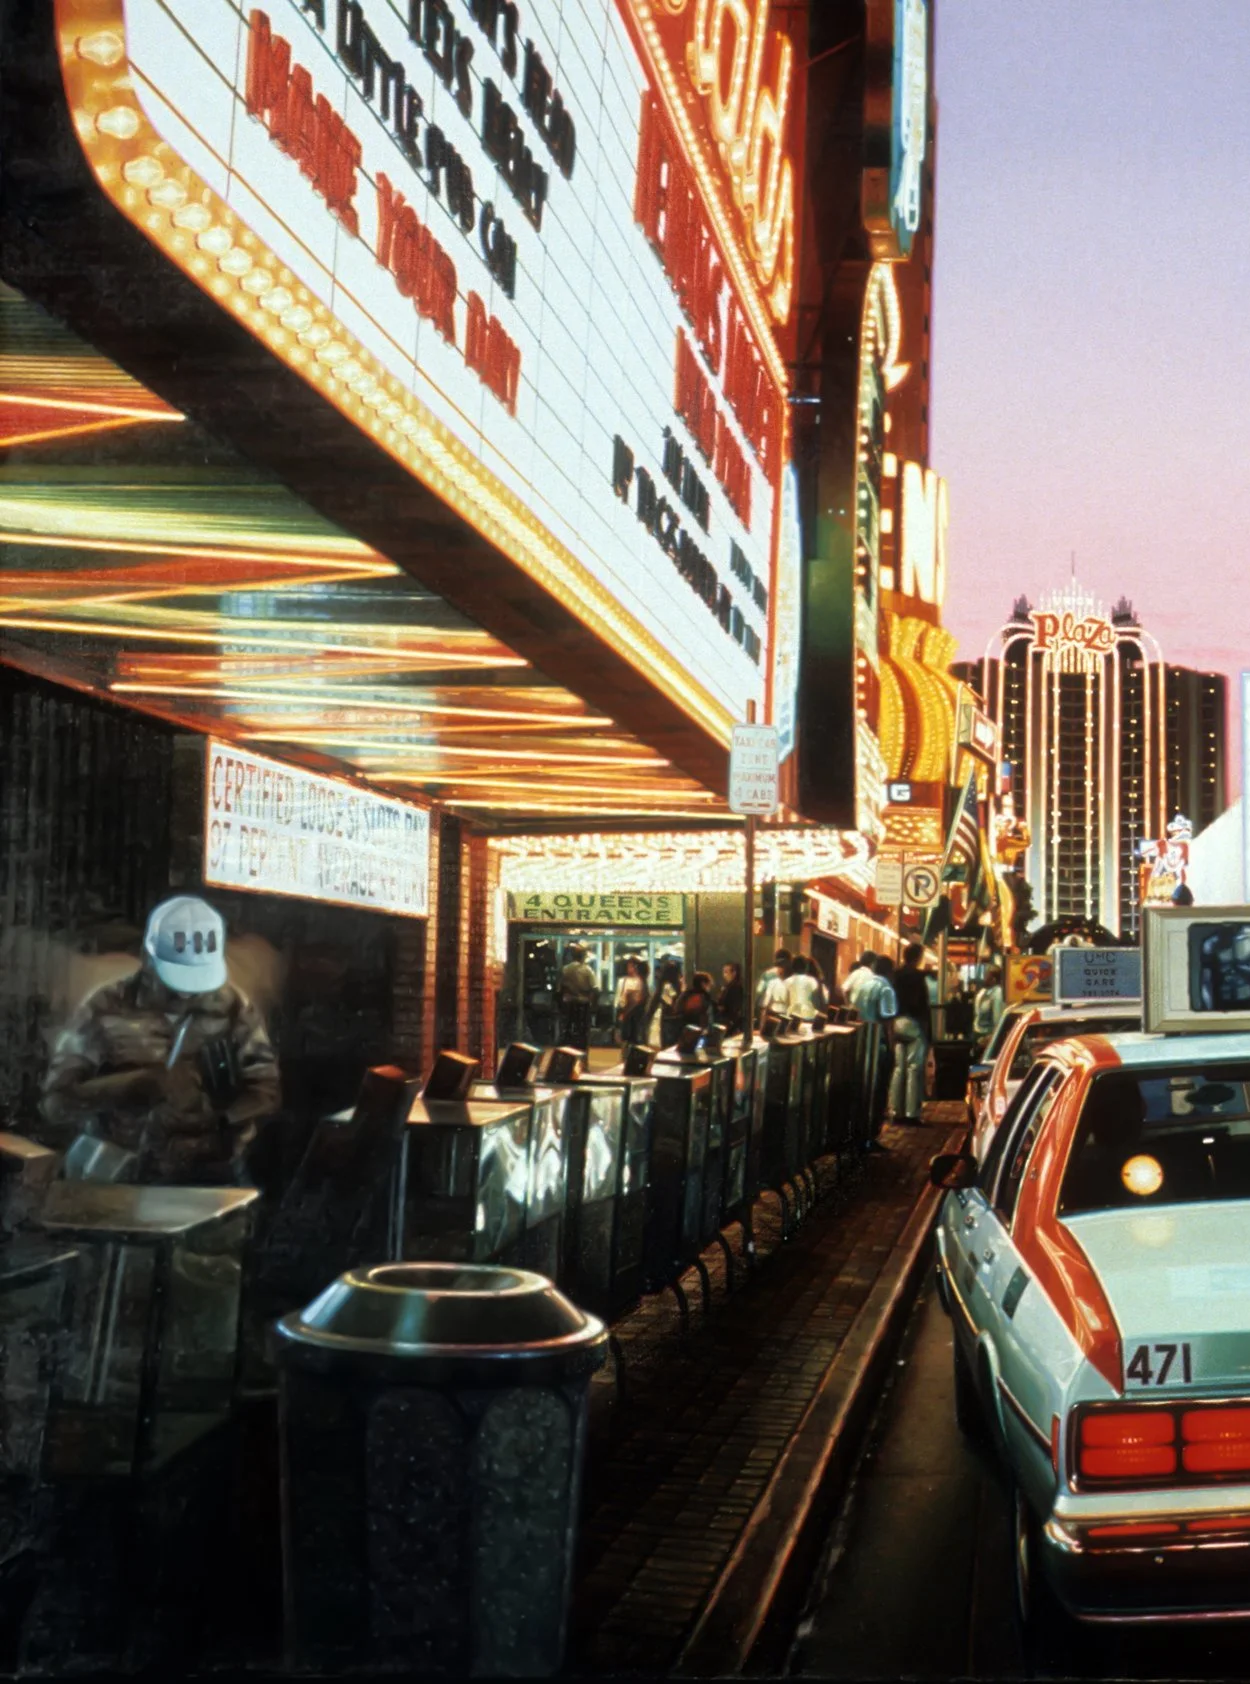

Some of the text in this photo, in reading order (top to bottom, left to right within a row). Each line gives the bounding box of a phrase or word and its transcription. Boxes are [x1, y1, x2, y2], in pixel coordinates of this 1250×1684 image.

[1029, 610, 1115, 653] Plaza
[522, 908, 672, 922] ENTRANCE
[525, 893, 671, 909] 4 QUEENS
[1126, 1342, 1193, 1385] 471
